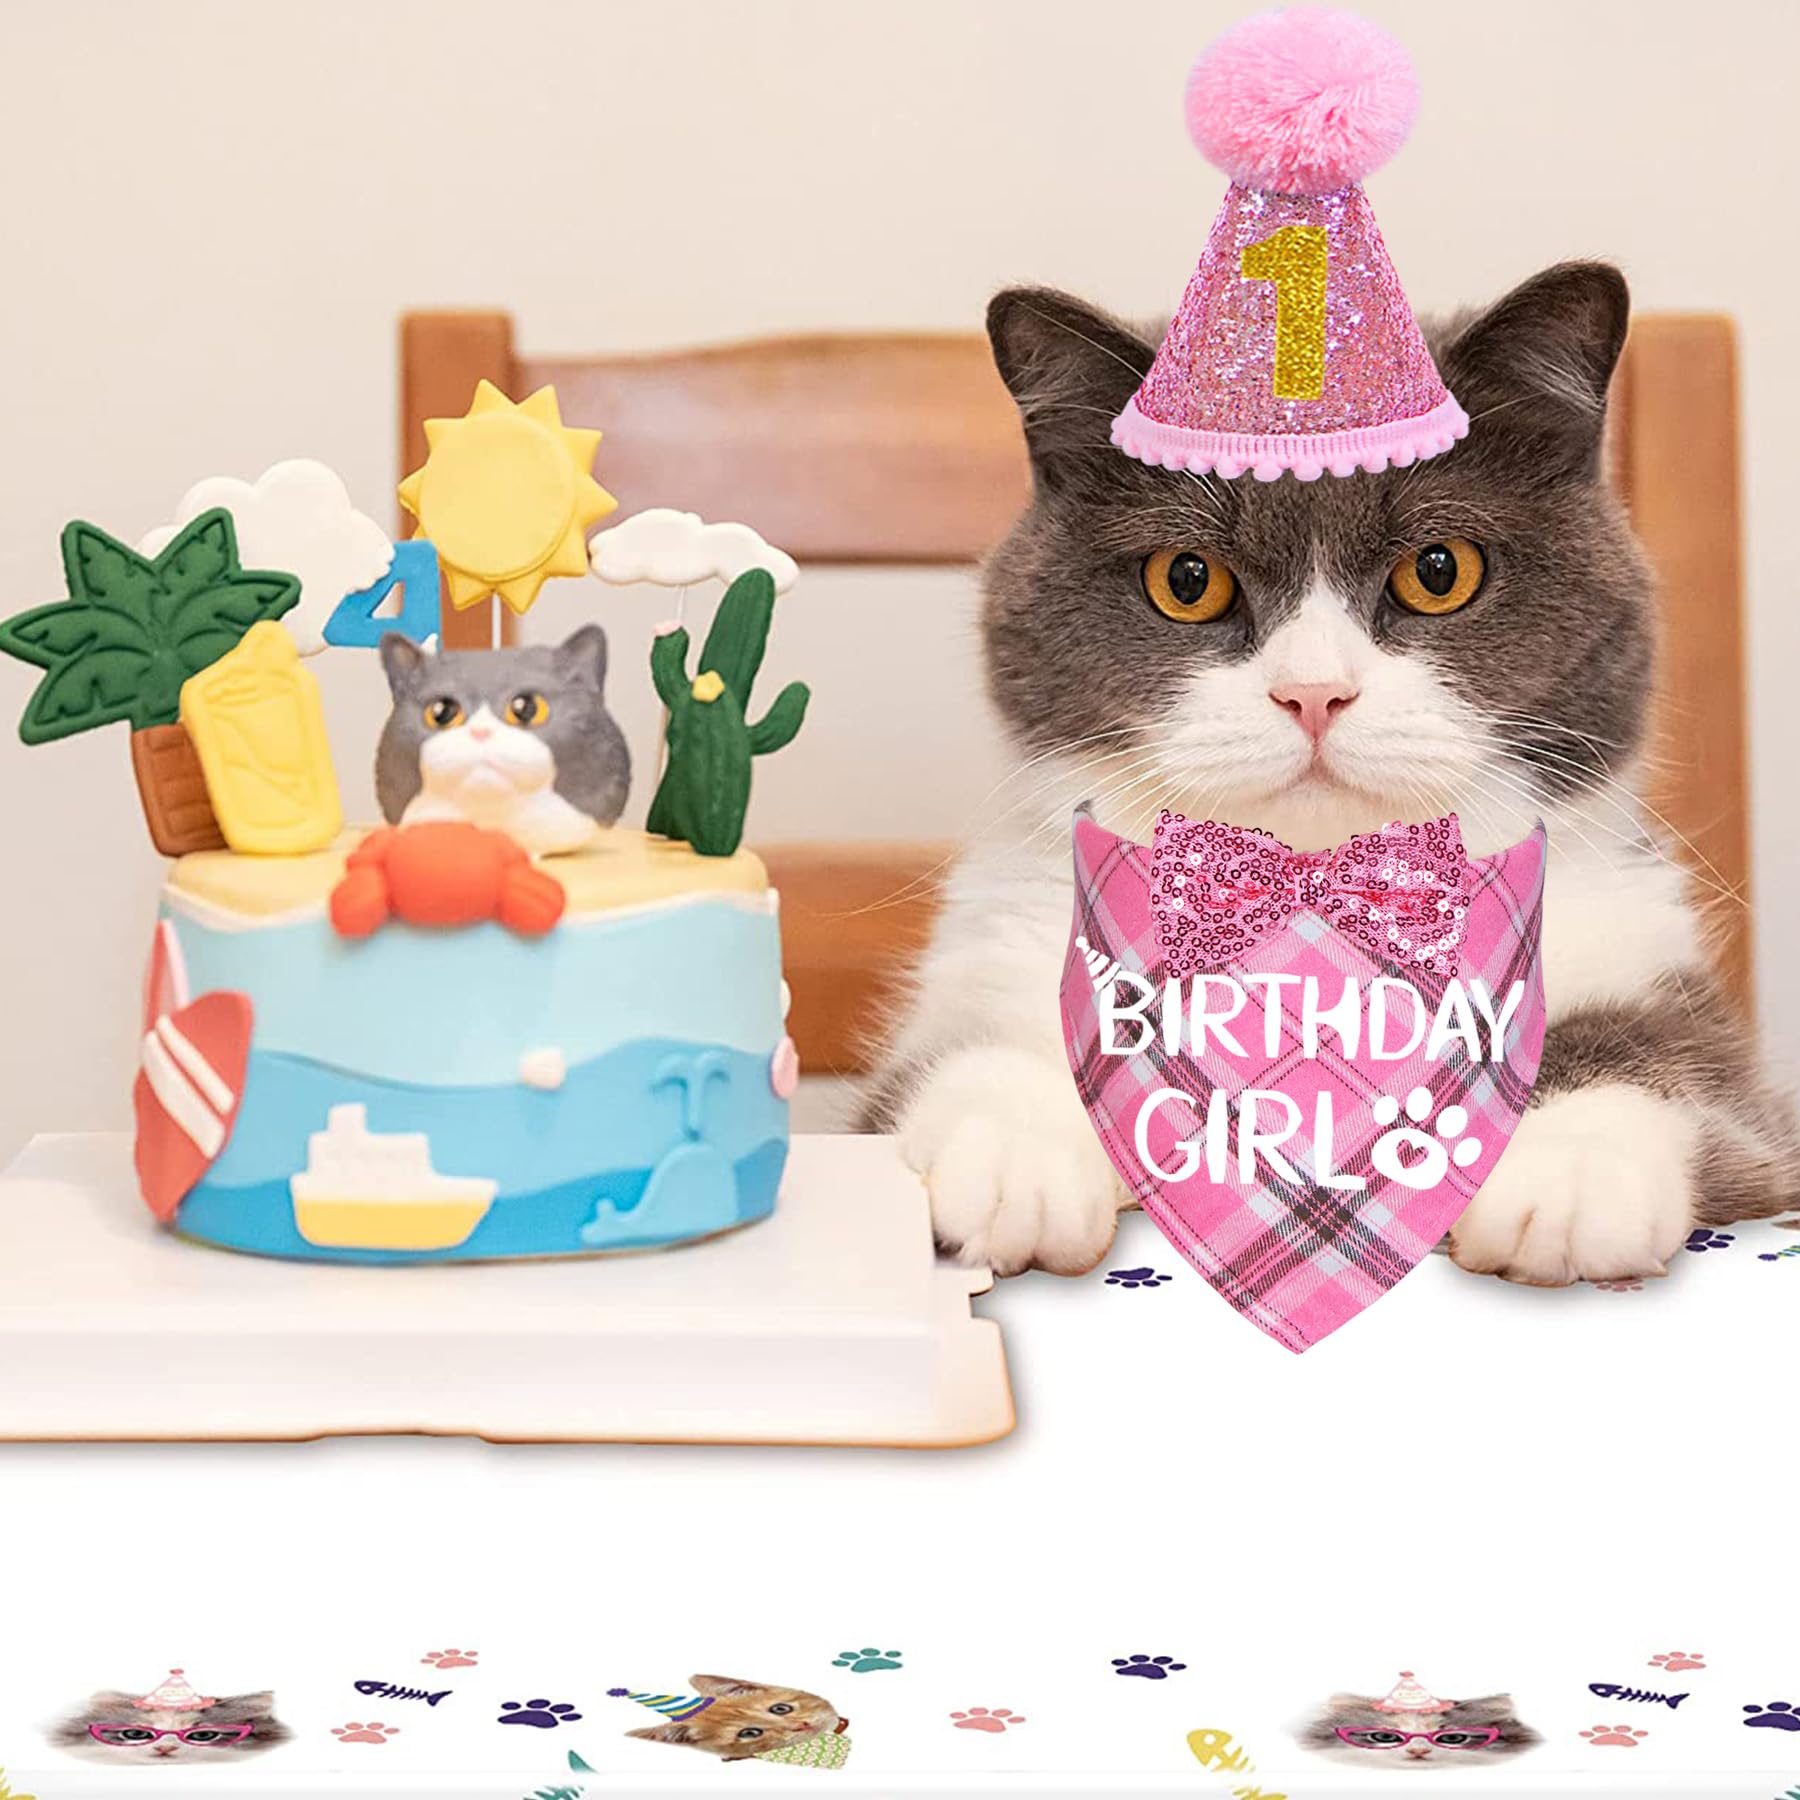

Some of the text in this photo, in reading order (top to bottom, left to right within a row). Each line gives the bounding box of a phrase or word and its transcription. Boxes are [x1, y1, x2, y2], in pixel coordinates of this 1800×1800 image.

[1241, 226, 1328, 400] 1
[323, 540, 441, 650] 4
[1100, 972, 1525, 1062] BIRTHDAY
[1134, 1087, 1366, 1190] GIRL
